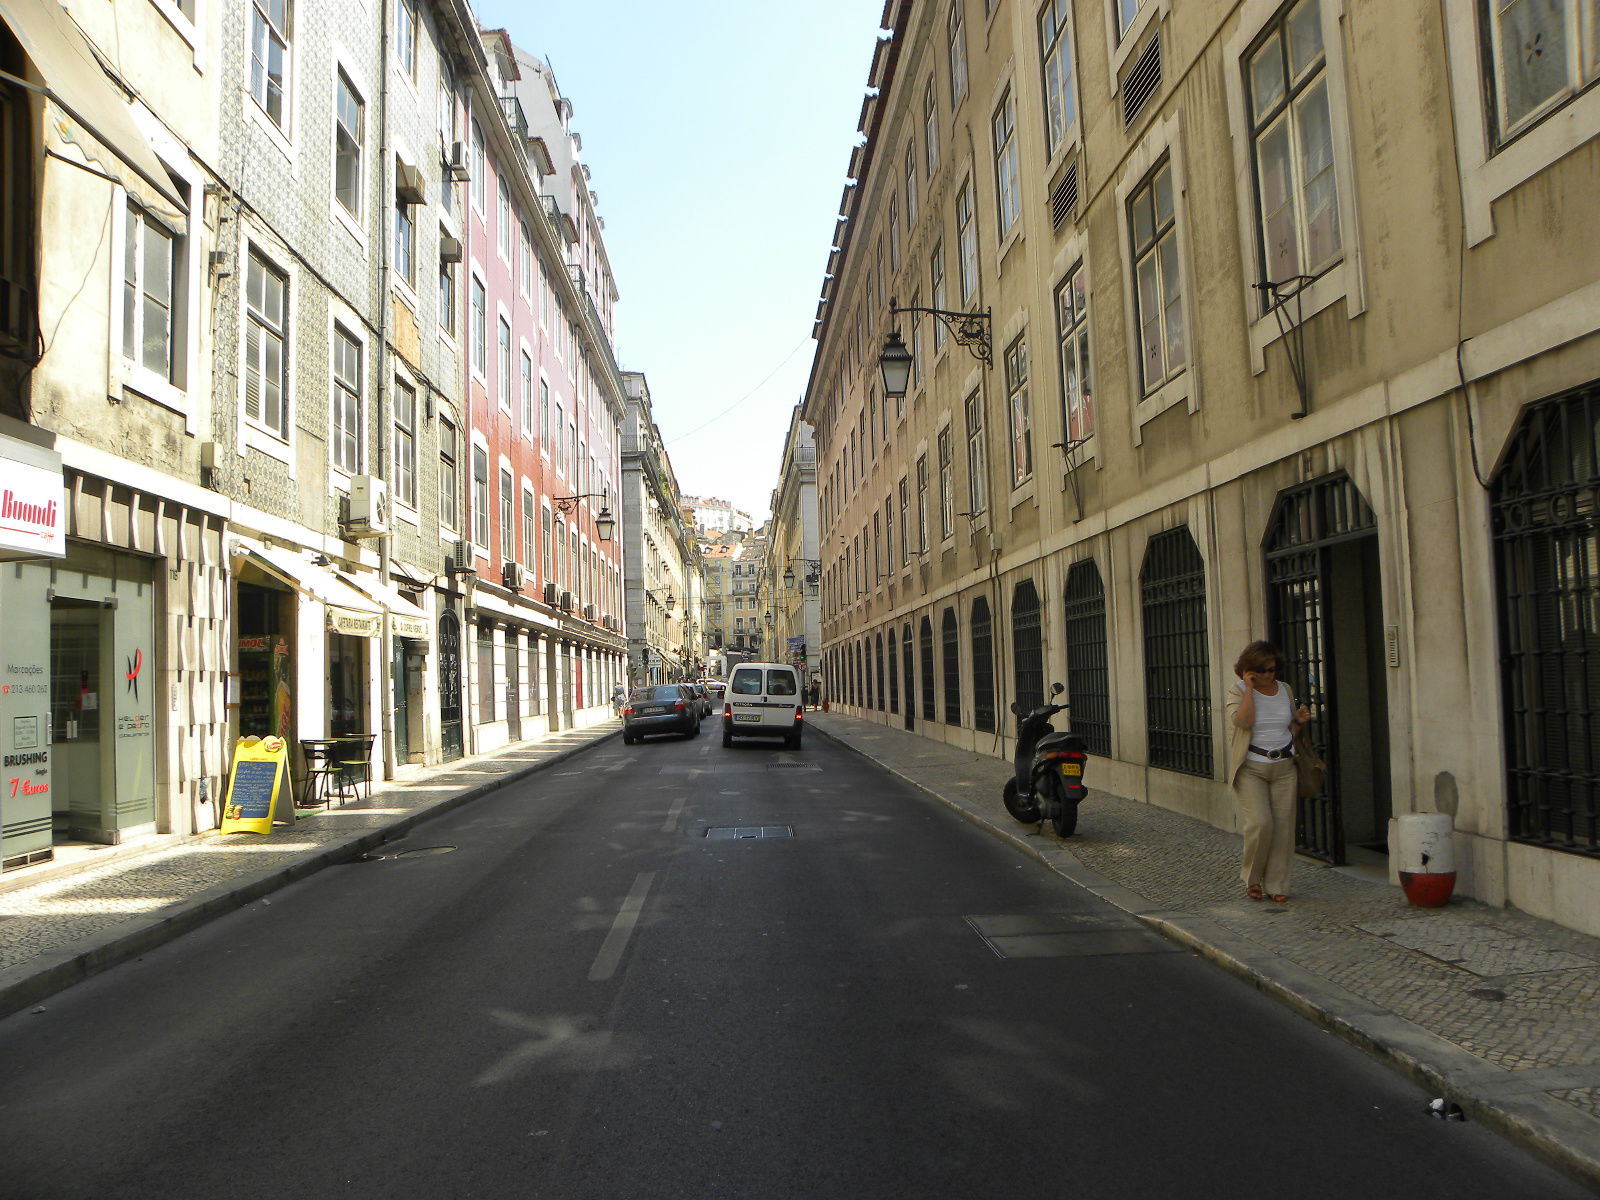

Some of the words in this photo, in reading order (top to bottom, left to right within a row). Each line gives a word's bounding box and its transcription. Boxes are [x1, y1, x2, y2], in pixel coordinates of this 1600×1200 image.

[2, 489, 57, 527] Buondi
[7, 664, 44, 676] Marcações
[12, 685, 23, 693] 213
[4, 751, 48, 767] BRUSHING
[9, 778, 19, 797] 7
